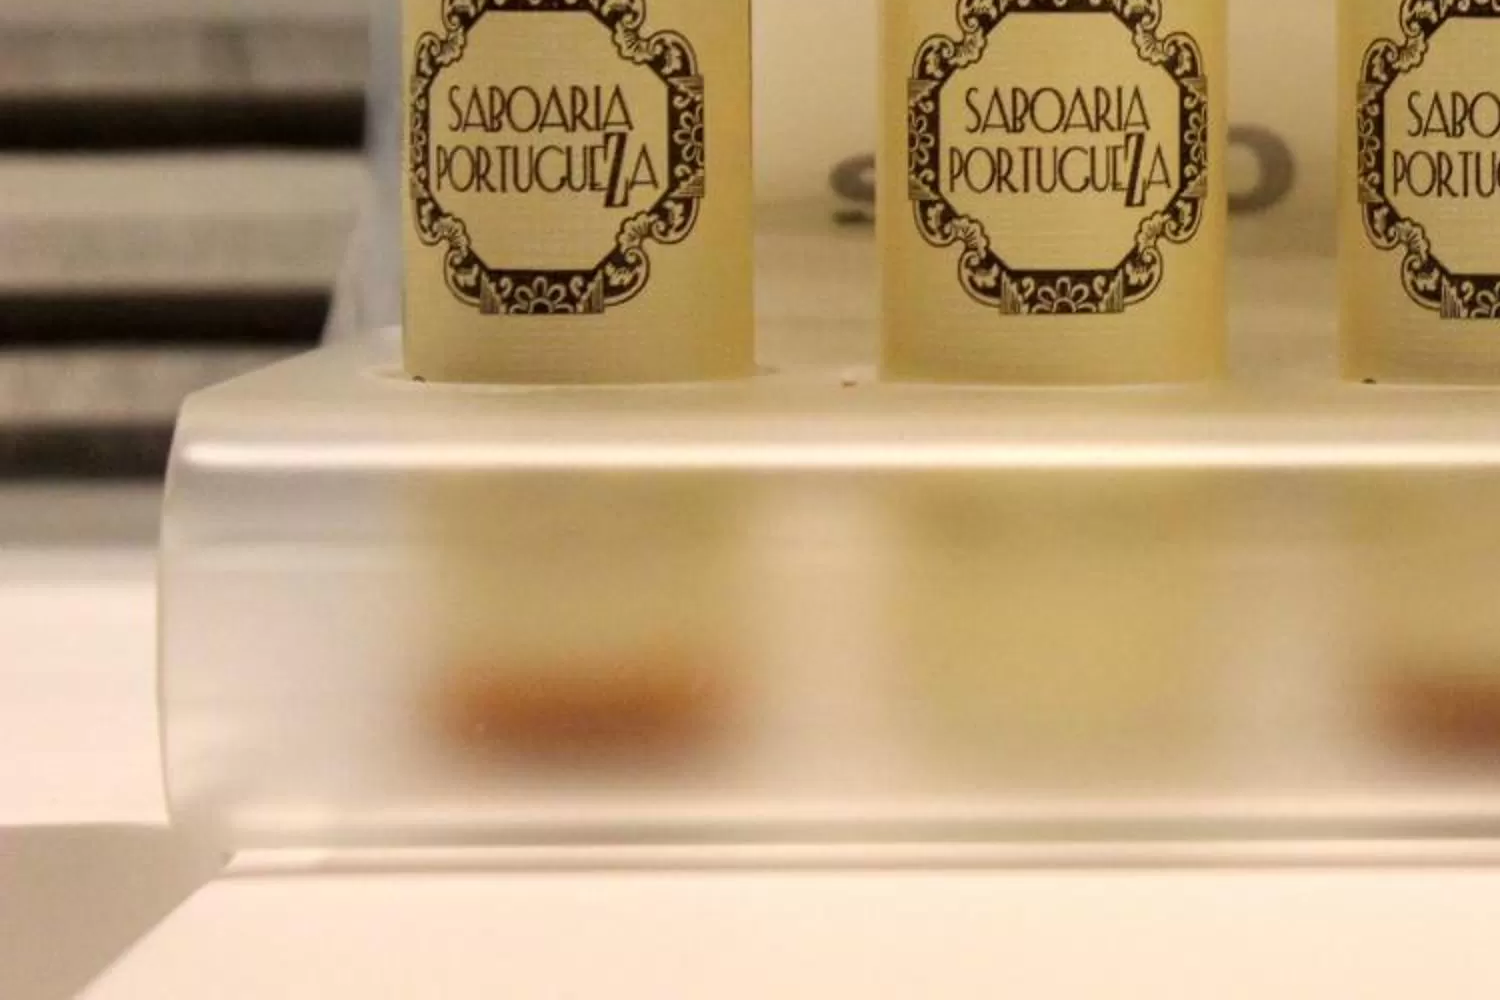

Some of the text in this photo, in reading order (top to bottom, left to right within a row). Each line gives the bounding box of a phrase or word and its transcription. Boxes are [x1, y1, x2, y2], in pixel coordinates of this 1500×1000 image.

[448, 84, 634, 132] SABOARIA
[965, 85, 1151, 133] SABOARIA
[436, 131, 659, 208] PORTUGUEZA
[948, 132, 1172, 208] PORTUGUEZA
